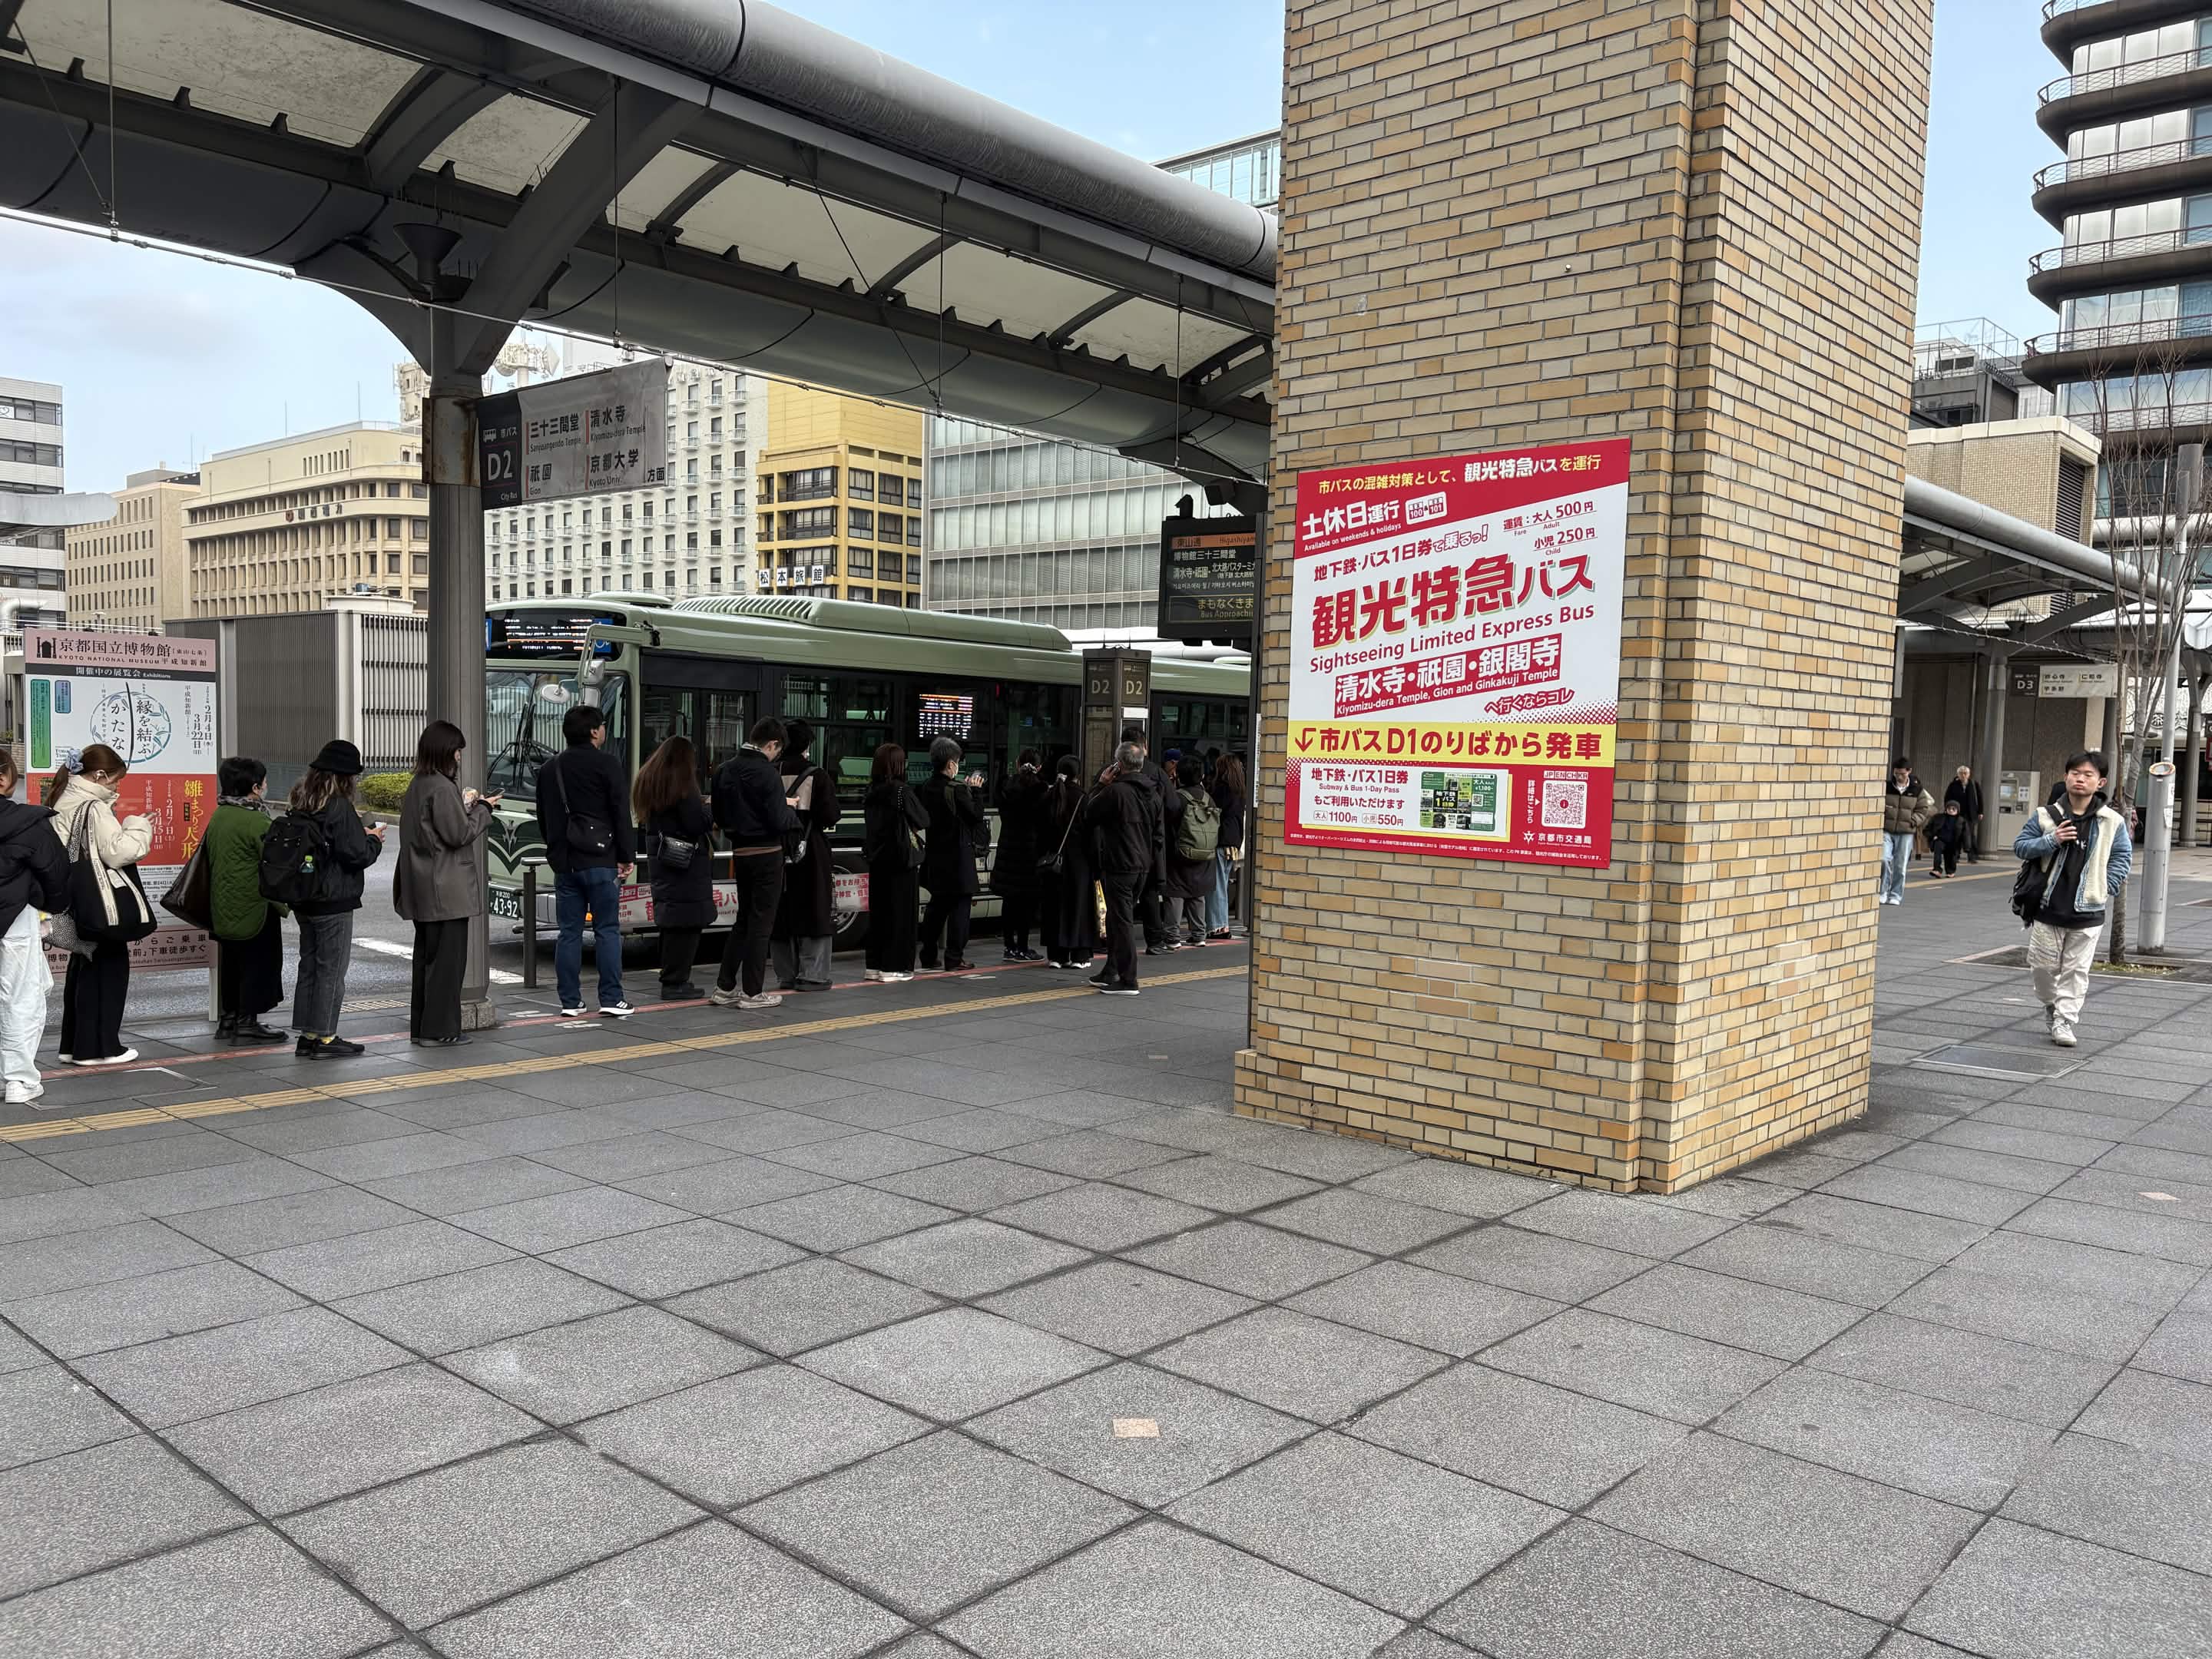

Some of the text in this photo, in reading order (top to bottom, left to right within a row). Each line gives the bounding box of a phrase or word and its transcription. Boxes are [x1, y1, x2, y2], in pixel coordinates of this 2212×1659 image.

[531, 412, 579, 439] 三十三間堂
[590, 405, 627, 428] 清水寺
[627, 424, 646, 436] Temple
[488, 449, 512, 481] D2
[590, 449, 639, 474] 京都大学
[530, 463, 552, 482] 祇園
[589, 474, 622, 488] Kyoto Univ.
[647, 467, 664, 483] 方面
[1302, 500, 1400, 541] 土休日運行
[1543, 522, 1560, 531] Adult
[1304, 539, 1330, 552] Available
[1341, 531, 1369, 543] weekends
[1376, 523, 1402, 535] holidays
[1545, 547, 1561, 556] Child
[760, 568, 823, 584] 松本旅館
[1312, 553, 1594, 650] 観光特急バス
[59, 638, 171, 657] 京都国立博物館
[1310, 604, 1594, 674] Sightseeing Limited Express Bus
[76, 667, 141, 677] 開催中の展覧会
[1336, 637, 1560, 703] 清水寺・祇園・銀閣寺
[1091, 680, 1111, 694] D2
[1126, 680, 1143, 695] D2
[1336, 667, 1558, 716] Kiyomizu-dera Temple, Gion and Ginkakuji Temple
[2017, 680, 2034, 690] D3
[1484, 687, 1575, 716] へ行くならコレ
[111, 703, 127, 750] かたな
[136, 700, 153, 754] 縁を結ぶ
[1320, 727, 1602, 760] 市バスD1のりばから発車
[1319, 783, 1343, 791] Subway
[1314, 795, 1405, 810] もご利用いただけます
[1329, 811, 1358, 823] 1100円
[1378, 814, 1404, 826] 550円
[1538, 833, 1592, 845] 京都市交通局
